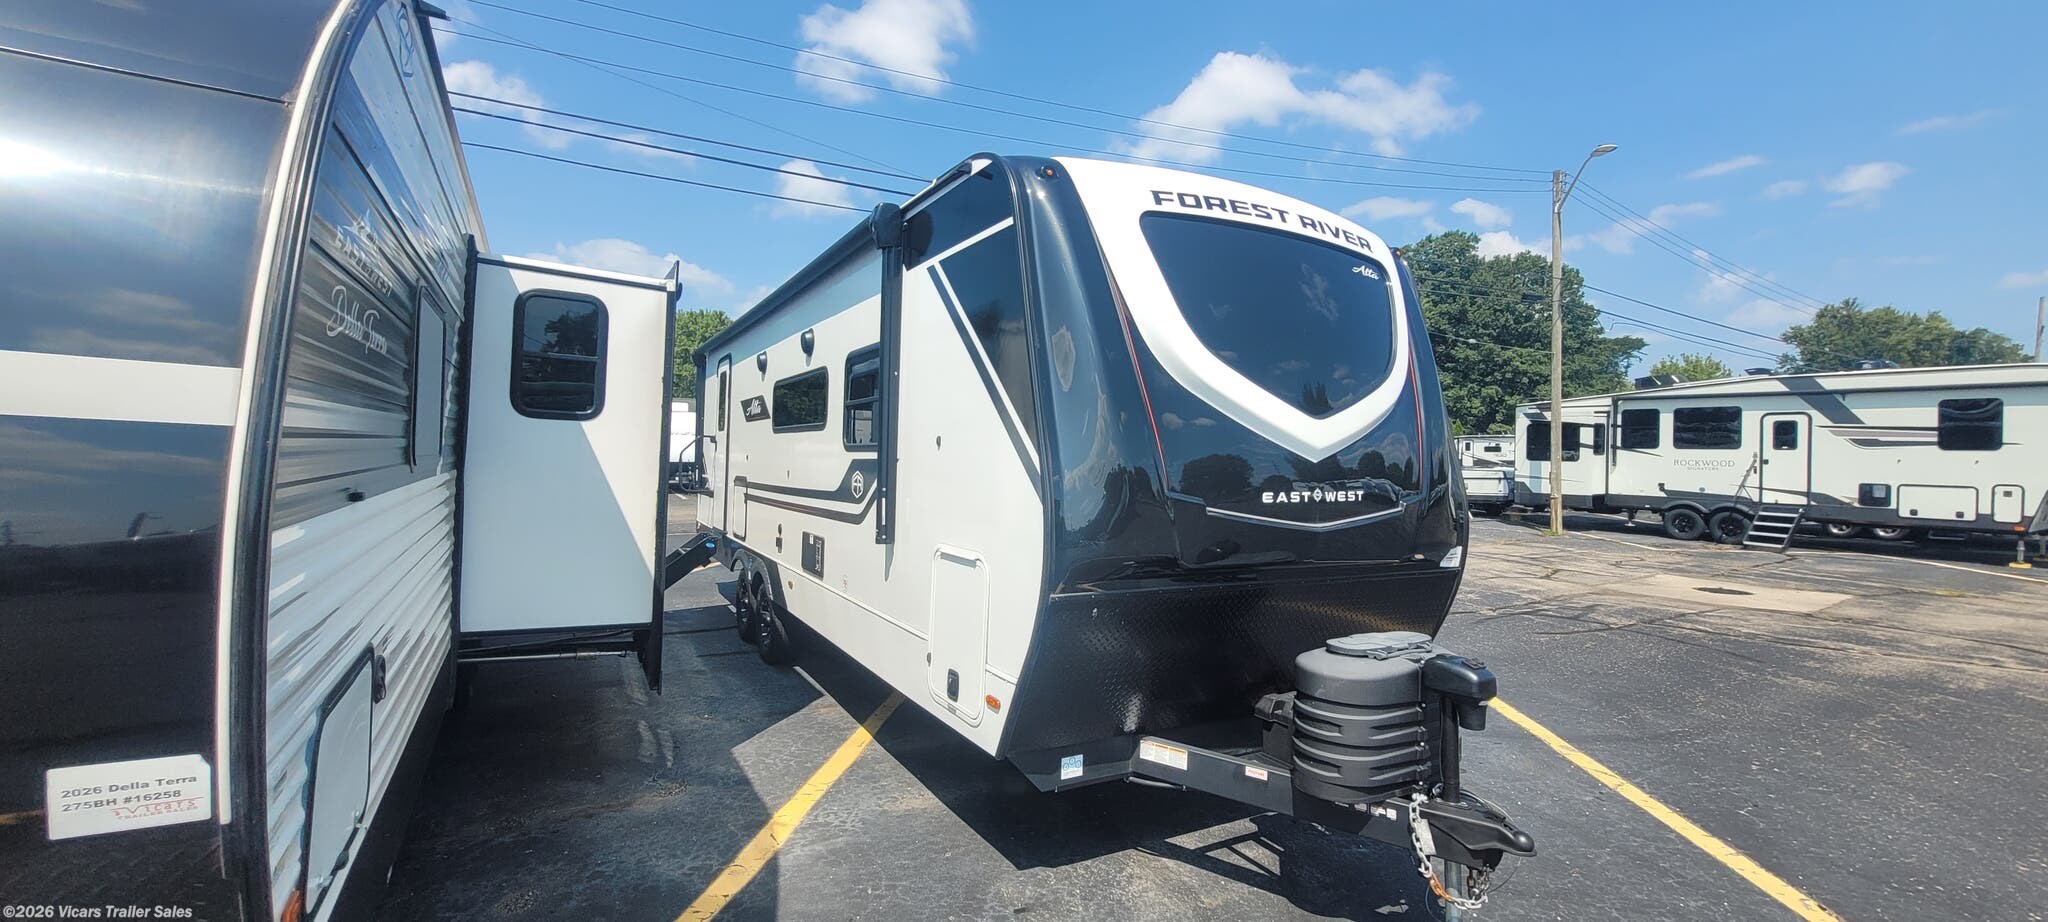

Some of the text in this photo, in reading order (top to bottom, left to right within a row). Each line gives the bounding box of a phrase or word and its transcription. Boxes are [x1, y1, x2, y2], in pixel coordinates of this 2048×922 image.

[1150, 190, 1374, 253] FOREST RIVER
[1352, 265, 1380, 281] Alta
[326, 285, 363, 341] Della
[1673, 459, 1735, 467] ROCKWOOD
[1262, 490, 1364, 503] EAST WEST
[61, 775, 198, 799] 2026 Della Terra
[62, 789, 182, 812] 275BH #16258
